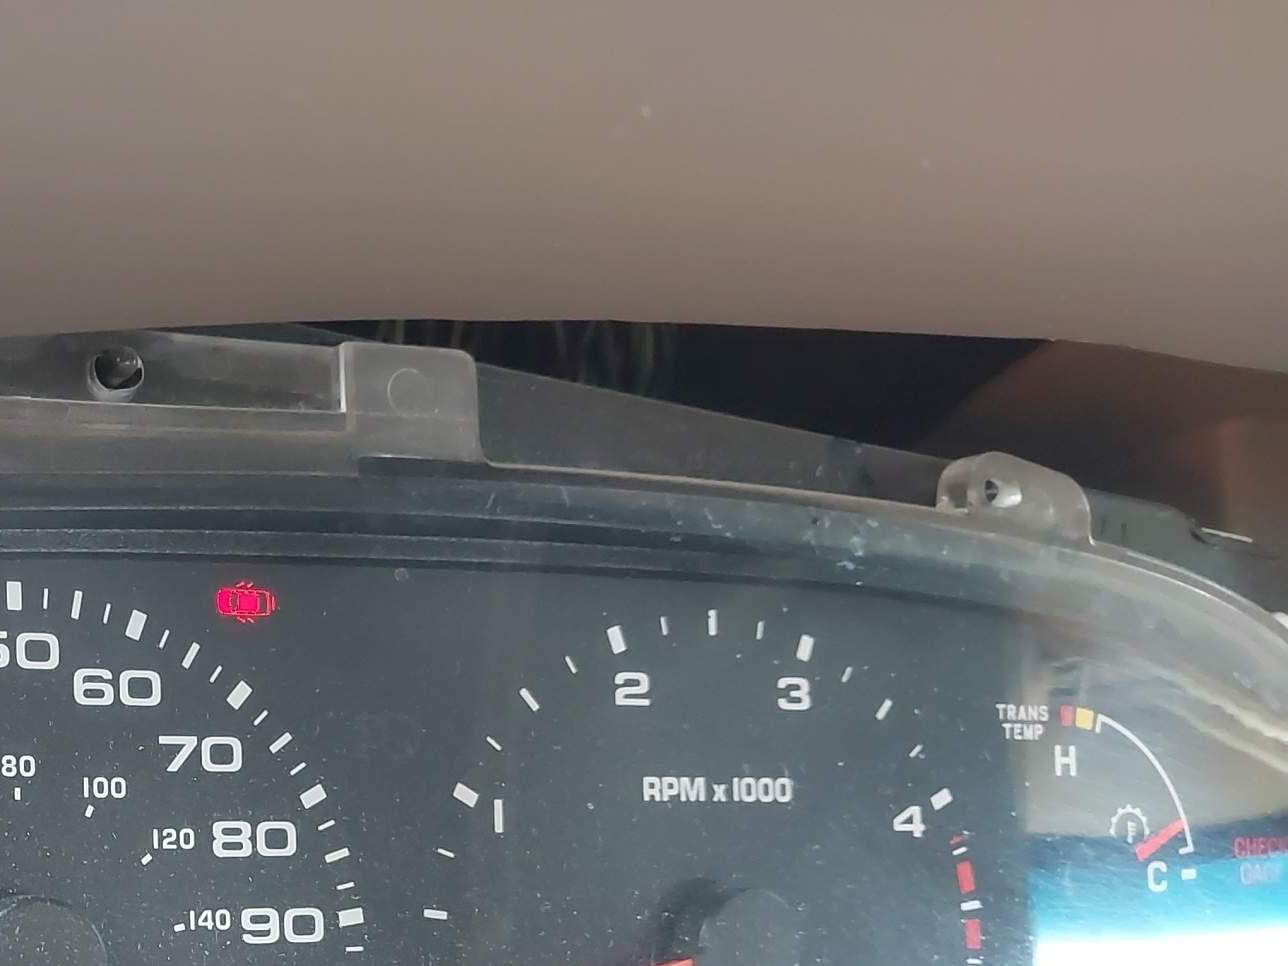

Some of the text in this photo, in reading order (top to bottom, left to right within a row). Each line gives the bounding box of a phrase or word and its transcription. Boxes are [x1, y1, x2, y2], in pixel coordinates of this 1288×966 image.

[72, 669, 162, 707] 60
[614, 671, 652, 706] 2
[776, 677, 812, 711] 3
[995, 703, 1049, 721] TRANS
[1002, 723, 1044, 740] TEMP
[0, 754, 37, 779] 80
[158, 735, 243, 772] 70
[1053, 745, 1078, 777] H
[81, 776, 128, 800] 100
[641, 776, 793, 804] RPM x 1000
[152, 825, 196, 850] 120
[892, 806, 926, 838] 4
[211, 820, 298, 859] 80
[1146, 860, 1169, 893] C
[187, 910, 232, 932] 140
[240, 907, 325, 943] 90
